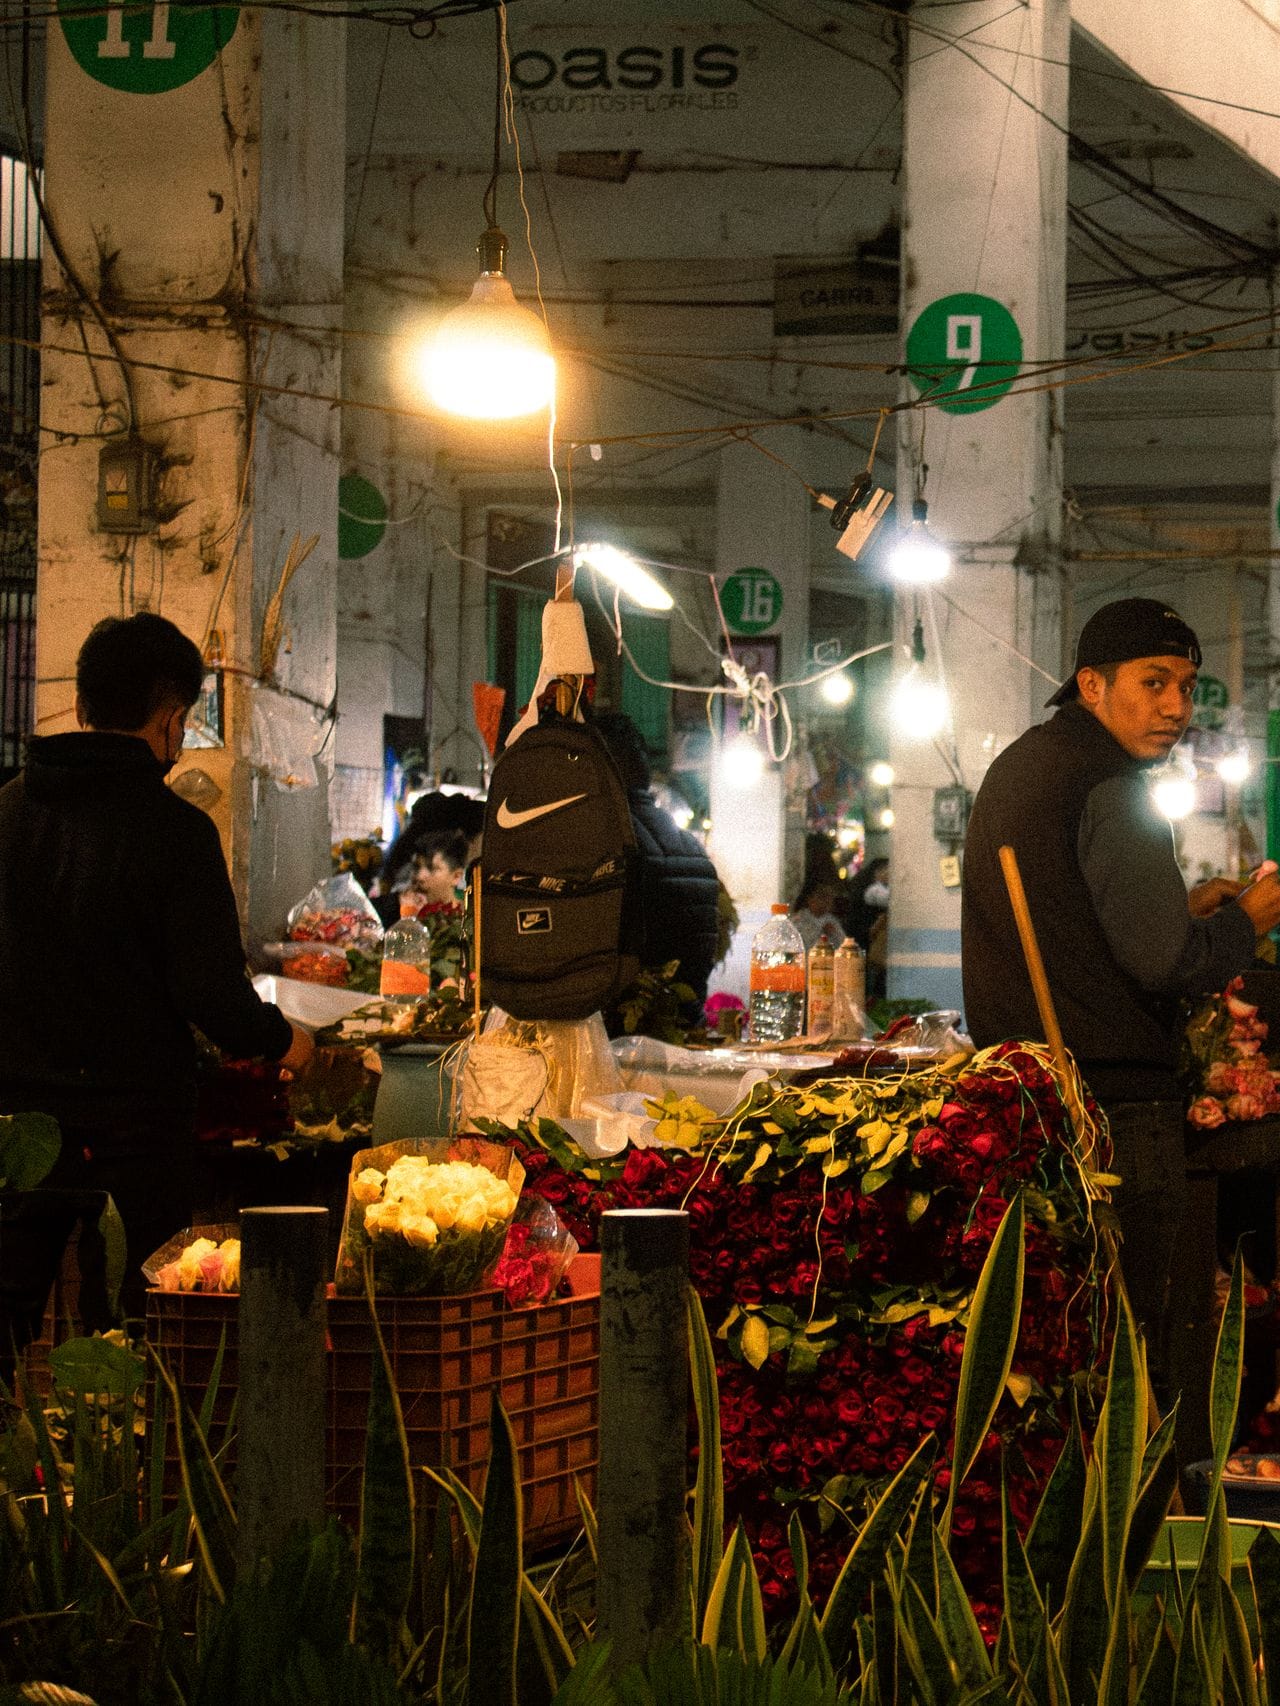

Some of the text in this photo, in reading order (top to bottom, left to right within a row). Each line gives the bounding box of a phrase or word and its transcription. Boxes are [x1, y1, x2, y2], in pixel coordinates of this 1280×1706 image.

[511, 44, 739, 89] oasis
[946, 315, 982, 391] 9
[740, 579, 773, 623] 16
